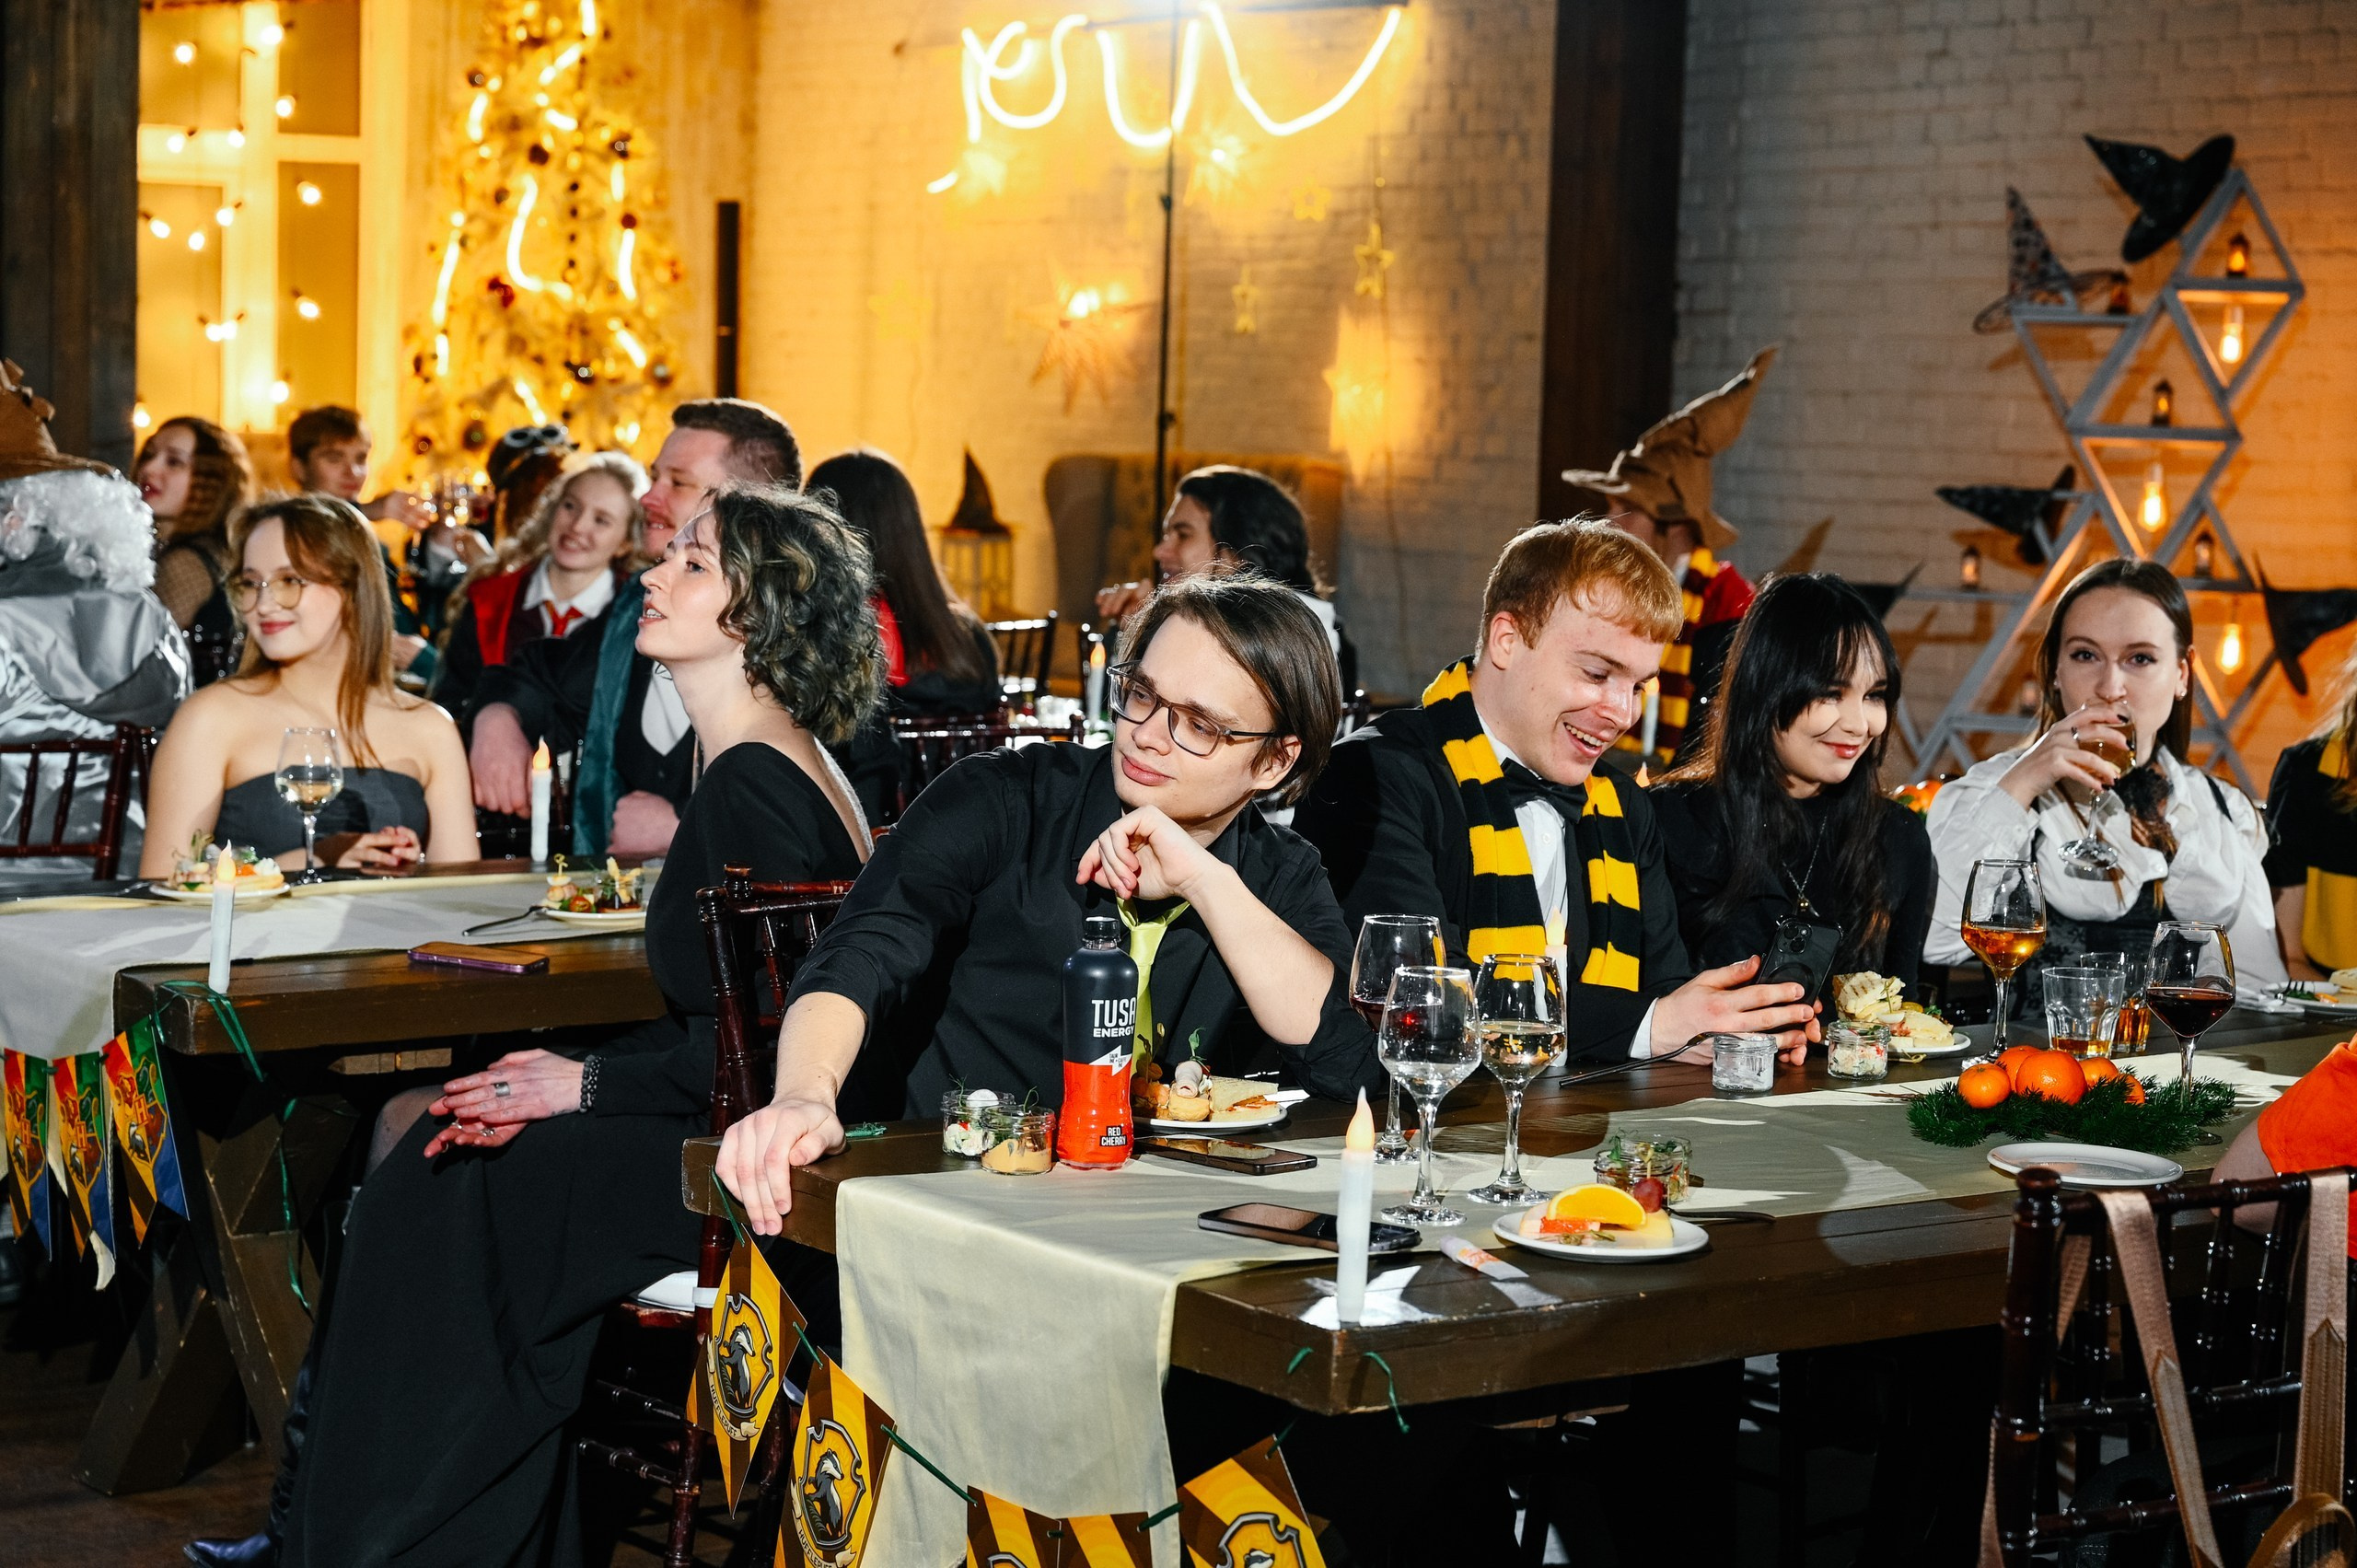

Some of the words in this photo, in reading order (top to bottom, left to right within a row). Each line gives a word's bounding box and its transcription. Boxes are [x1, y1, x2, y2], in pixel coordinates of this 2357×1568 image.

[1091, 996, 1136, 1028] TUSA
[1093, 1025, 1135, 1038] ENERGY
[1108, 1126, 1121, 1136] RED
[1101, 1135, 1126, 1146] CHERRY
[710, 1384, 737, 1437] HUFFLEPUFF
